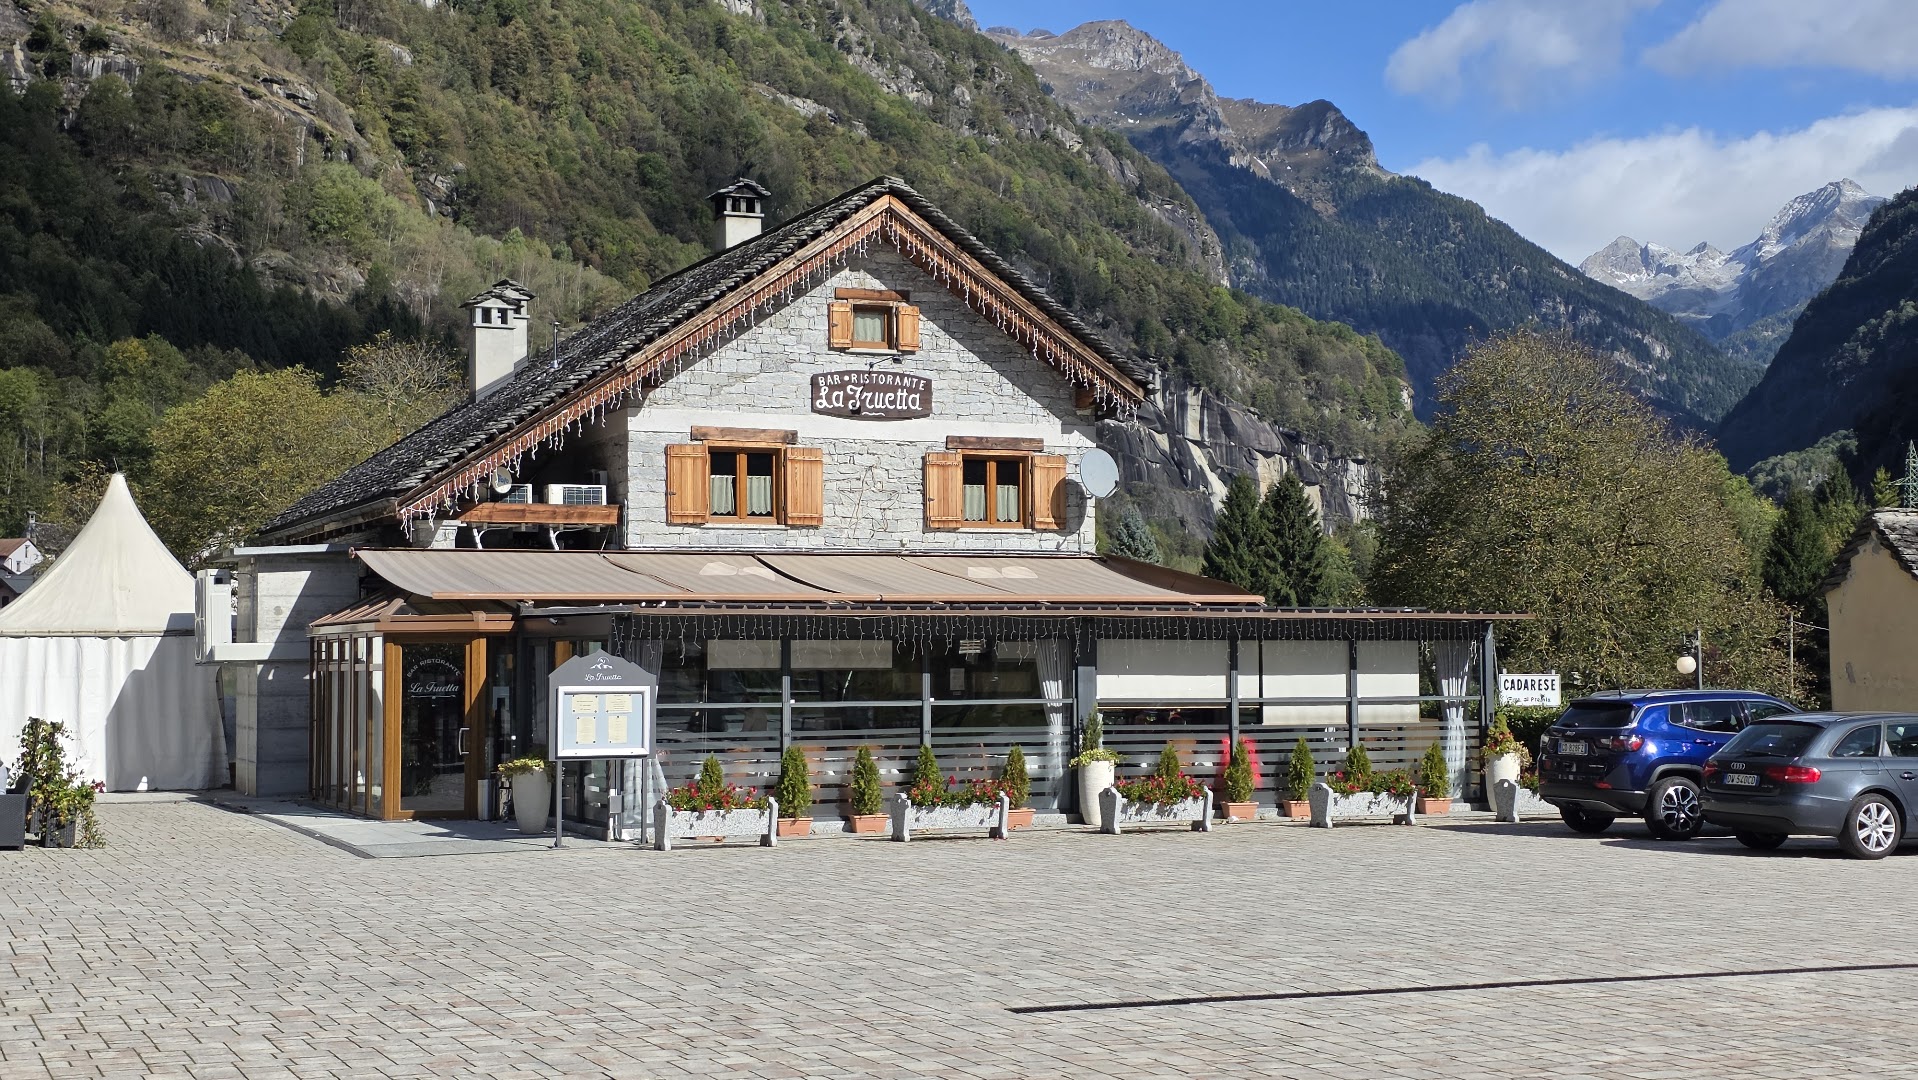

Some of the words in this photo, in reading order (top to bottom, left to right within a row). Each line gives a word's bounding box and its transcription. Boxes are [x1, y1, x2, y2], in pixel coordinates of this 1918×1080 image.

[818, 375, 841, 386] BAR
[851, 373, 927, 391] RISTORANTE
[816, 386, 845, 409] La
[847, 384, 923, 411] Fruetta
[406, 664, 418, 678] BAR
[420, 658, 461, 676] RISTORANTE
[407, 682, 423, 693] La
[424, 681, 459, 693] Fruetta
[1503, 678, 1556, 691] CADARESE
